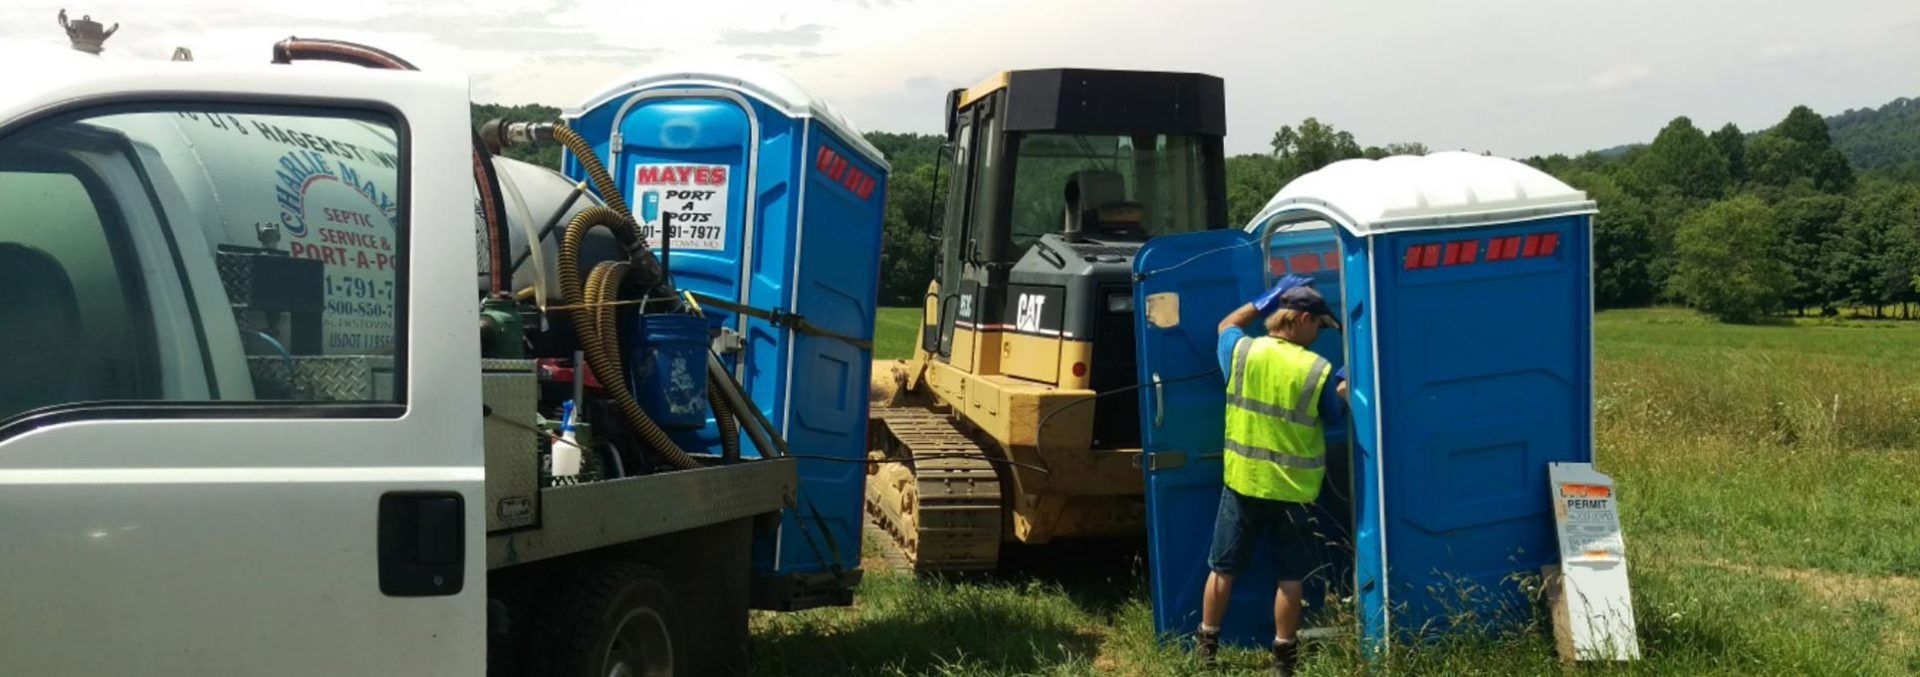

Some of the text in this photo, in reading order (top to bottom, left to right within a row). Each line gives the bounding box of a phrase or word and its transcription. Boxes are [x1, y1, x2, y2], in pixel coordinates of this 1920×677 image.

[637, 165, 726, 186] MAYES
[275, 149, 397, 237] CHARLIE MAY
[666, 190, 716, 200] PORT
[681, 202, 694, 211] A
[323, 207, 374, 228] SEPTIC
[667, 213, 712, 222] POTS
[319, 228, 391, 251] SERVICE &
[640, 225, 721, 239] 01-91-7977
[1017, 292, 1046, 331] CAT
[330, 331, 361, 348] USDOT
[1567, 499, 1608, 509] PERMIT
